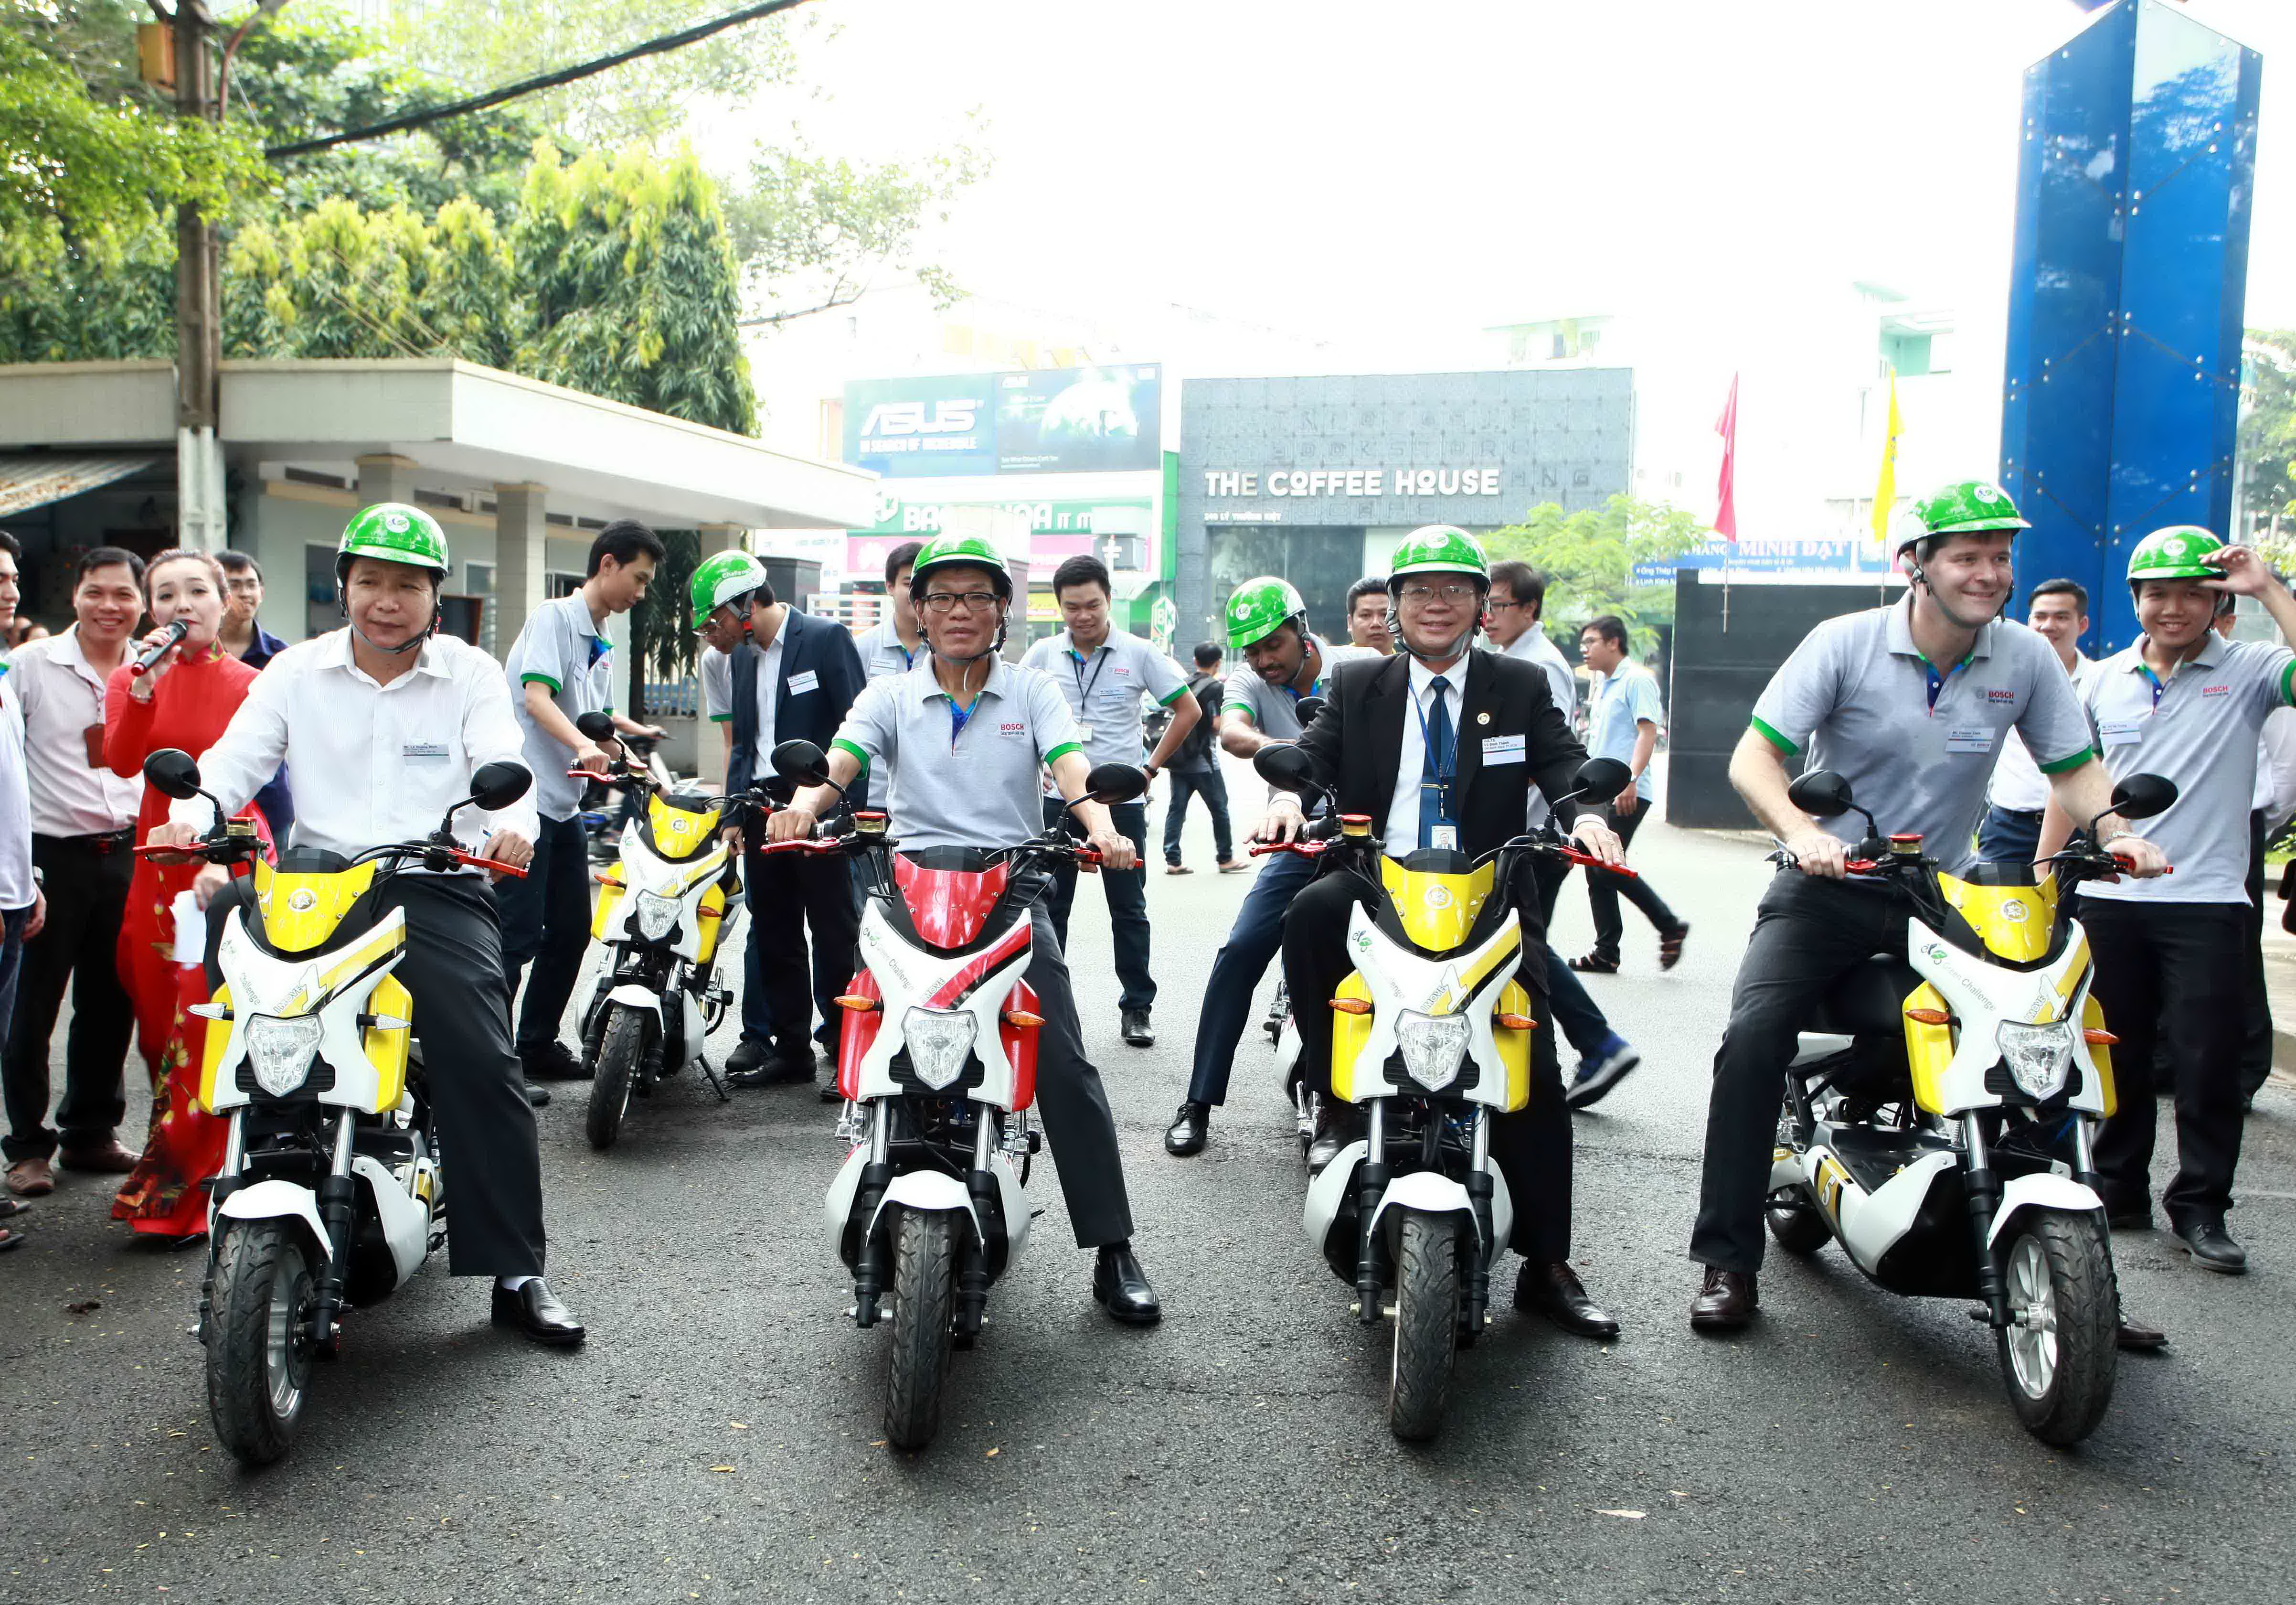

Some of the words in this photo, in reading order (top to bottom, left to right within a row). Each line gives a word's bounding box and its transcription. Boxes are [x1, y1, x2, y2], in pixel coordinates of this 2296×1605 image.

[860, 399, 976, 436] ASUS
[1204, 471, 1258, 496] THE
[1267, 470, 1382, 496] COFFEE
[1394, 469, 1499, 495] HOUSE
[1739, 542, 1796, 557] MINH
[239, 972, 261, 1006] Challenge
[889, 958, 914, 992] Challenge
[1961, 978, 1996, 1012] Challenge
[1820, 1179, 1835, 1206] 5
